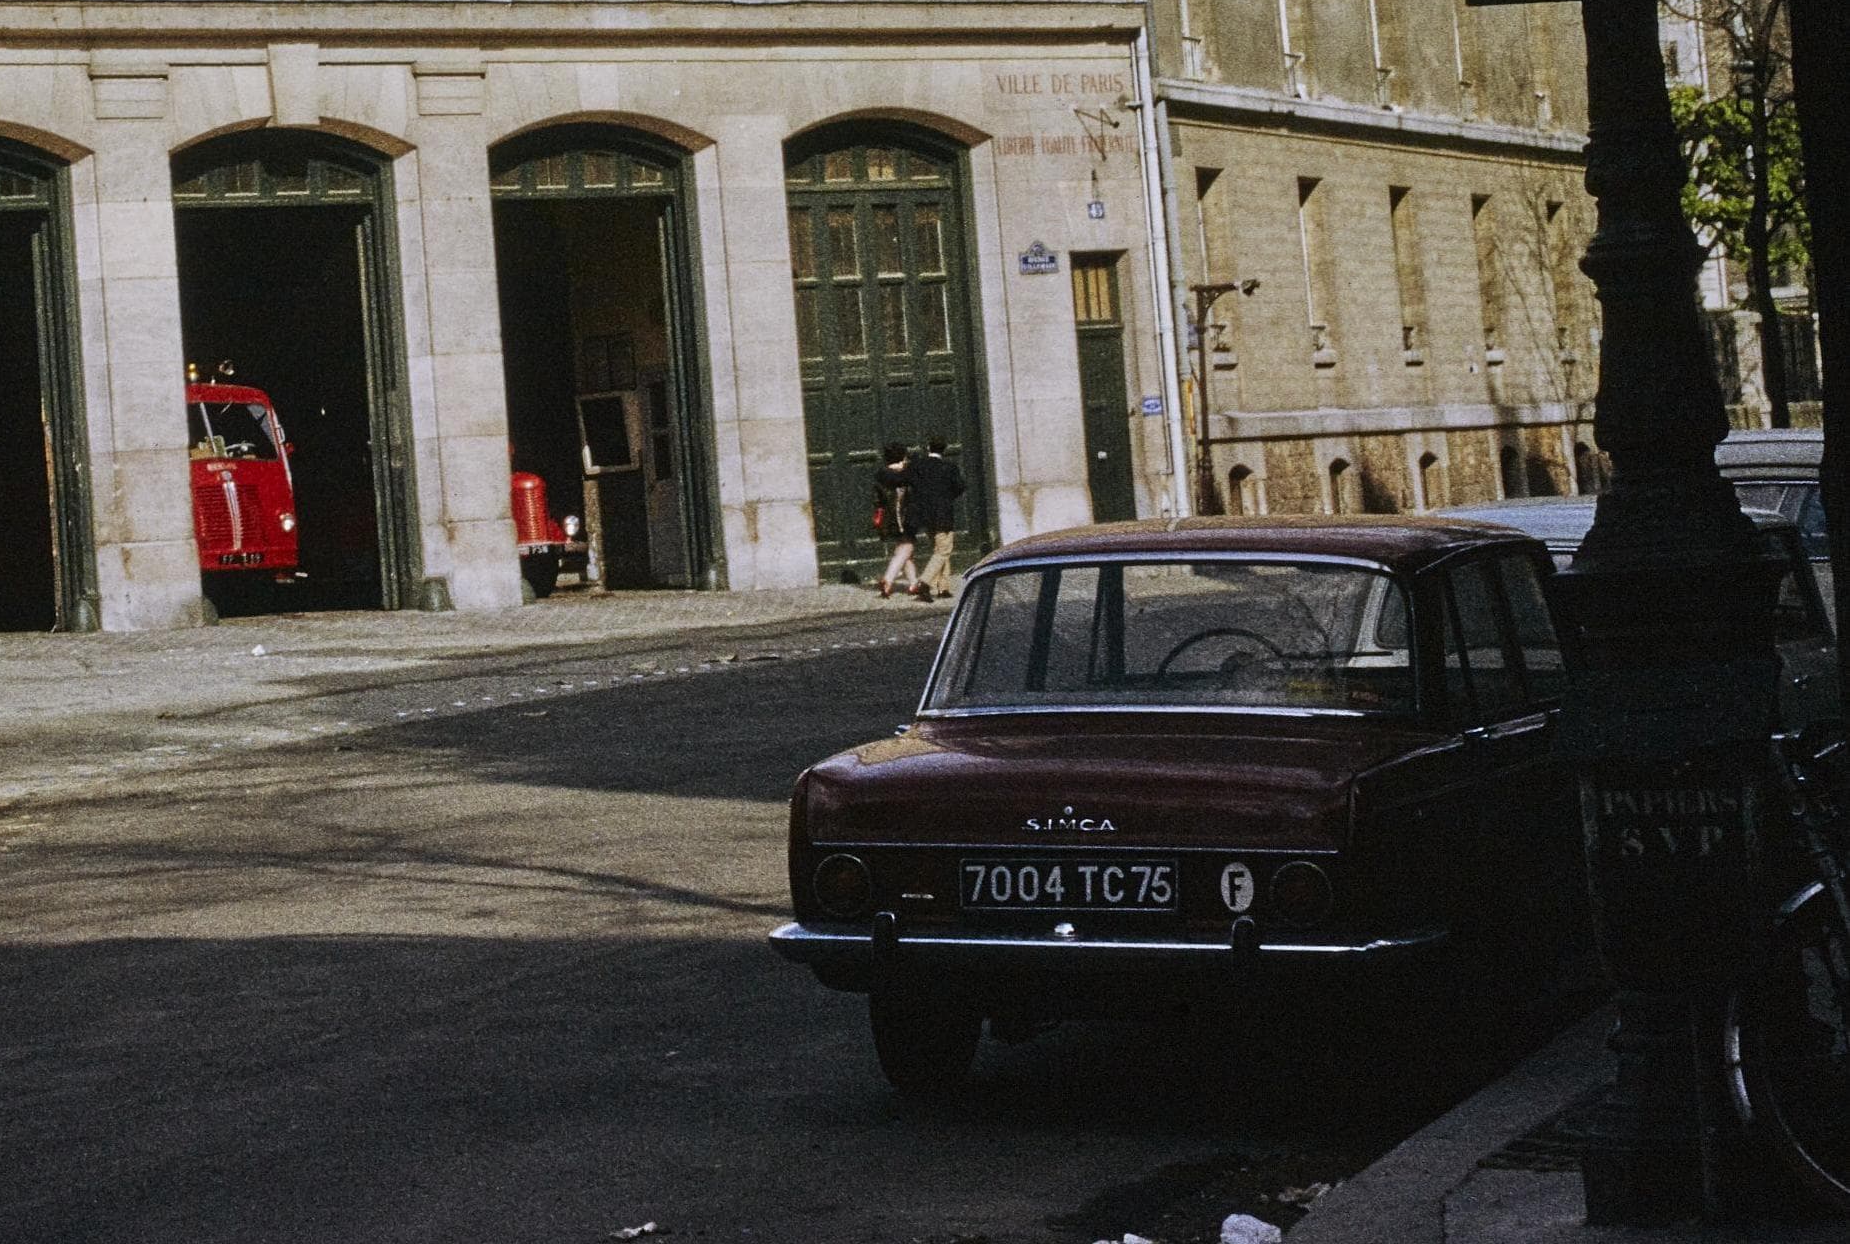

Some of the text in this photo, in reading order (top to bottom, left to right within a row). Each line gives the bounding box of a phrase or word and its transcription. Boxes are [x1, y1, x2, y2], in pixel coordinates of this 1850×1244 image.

[996, 72, 1124, 94] VILLE DE PARIS
[1026, 818, 1116, 831] SIMCA
[966, 865, 1065, 902] 7004
